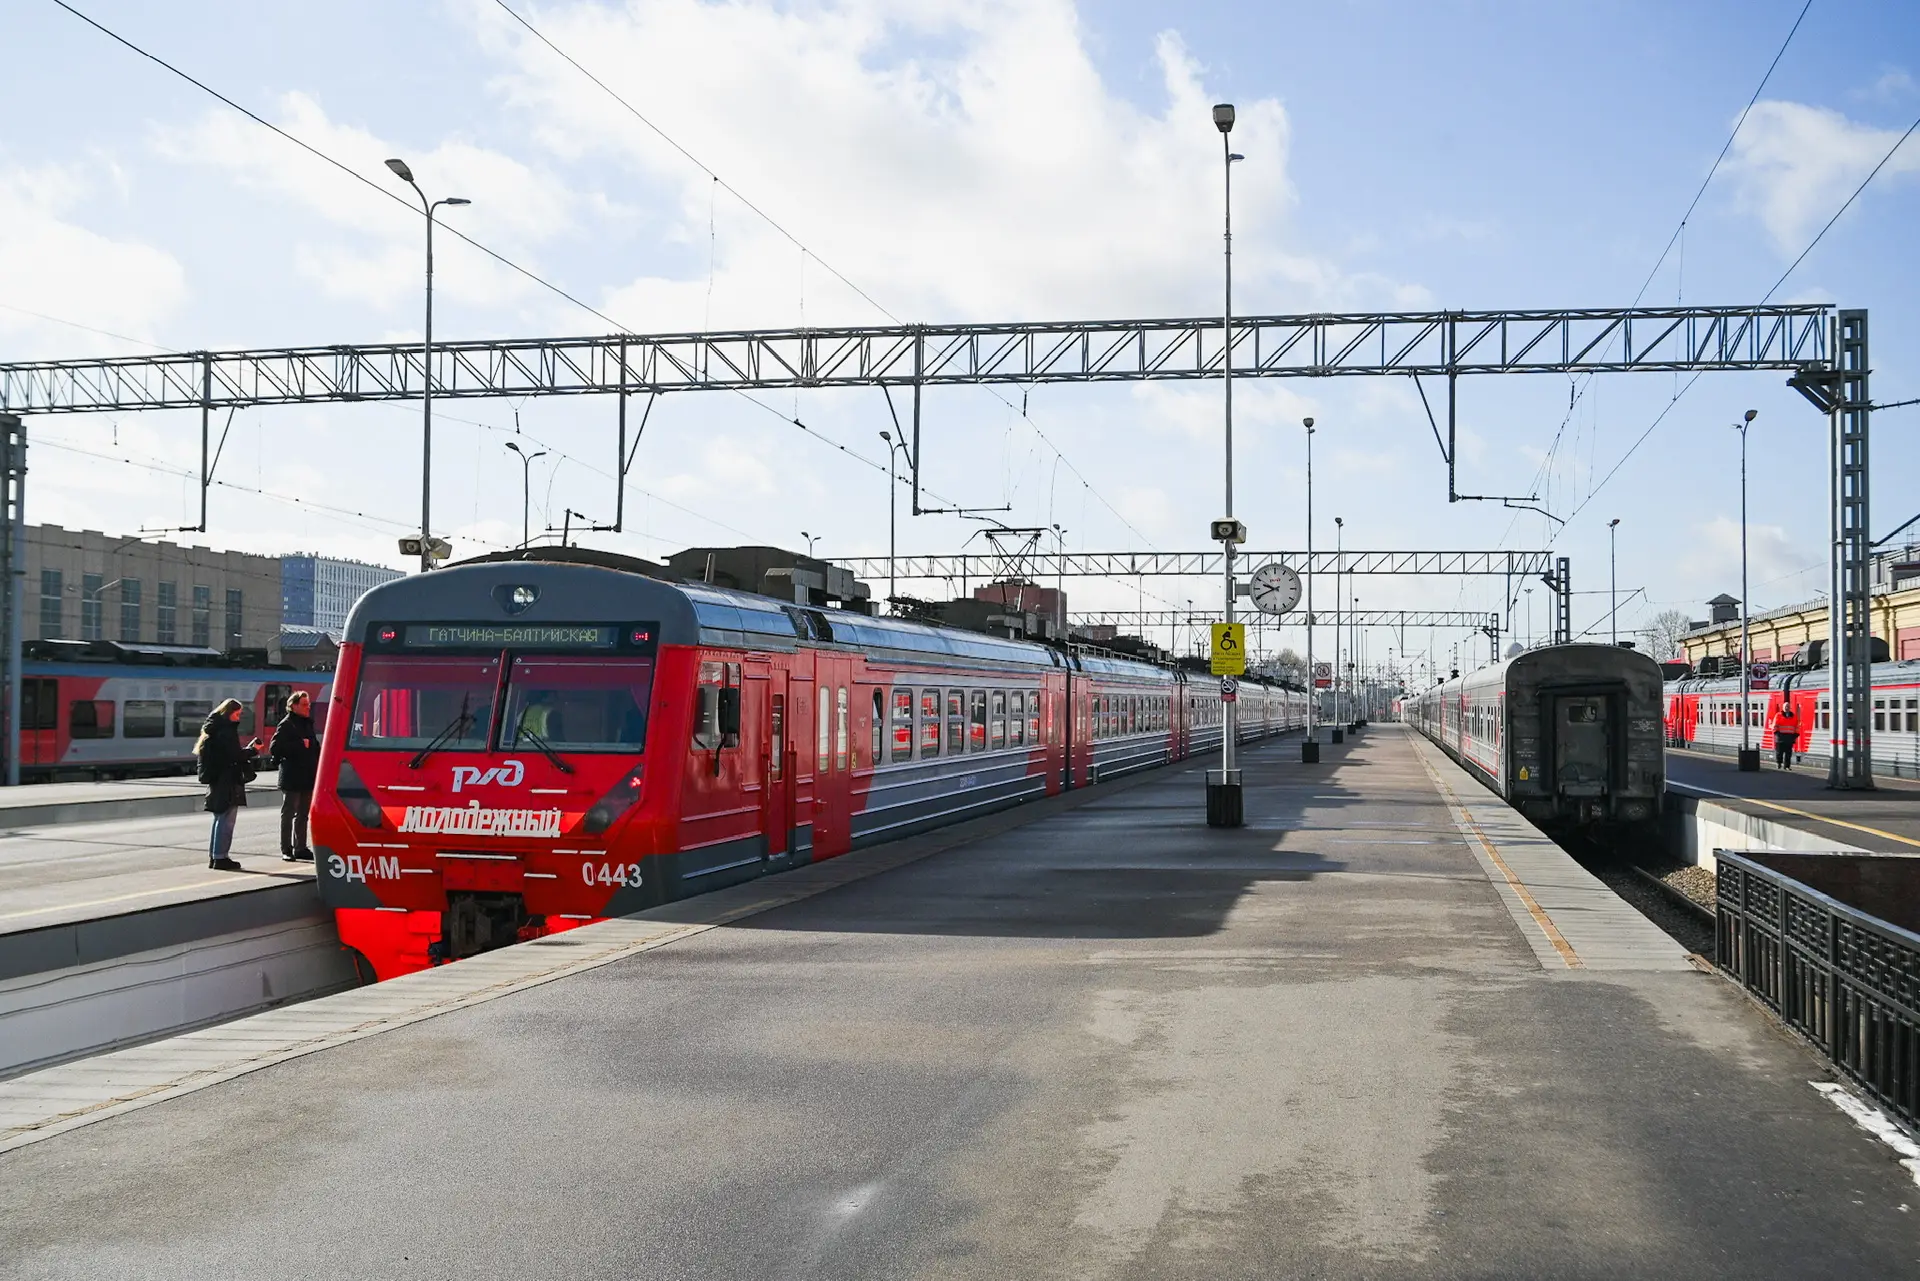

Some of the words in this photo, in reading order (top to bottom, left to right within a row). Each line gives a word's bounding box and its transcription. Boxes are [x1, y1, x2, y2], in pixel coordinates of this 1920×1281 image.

[428, 627, 599, 643] ГАТЧИНА-БАЛТИЙСКАЯ
[327, 854, 401, 883] ЭД4М
[582, 861, 643, 888] 0443
